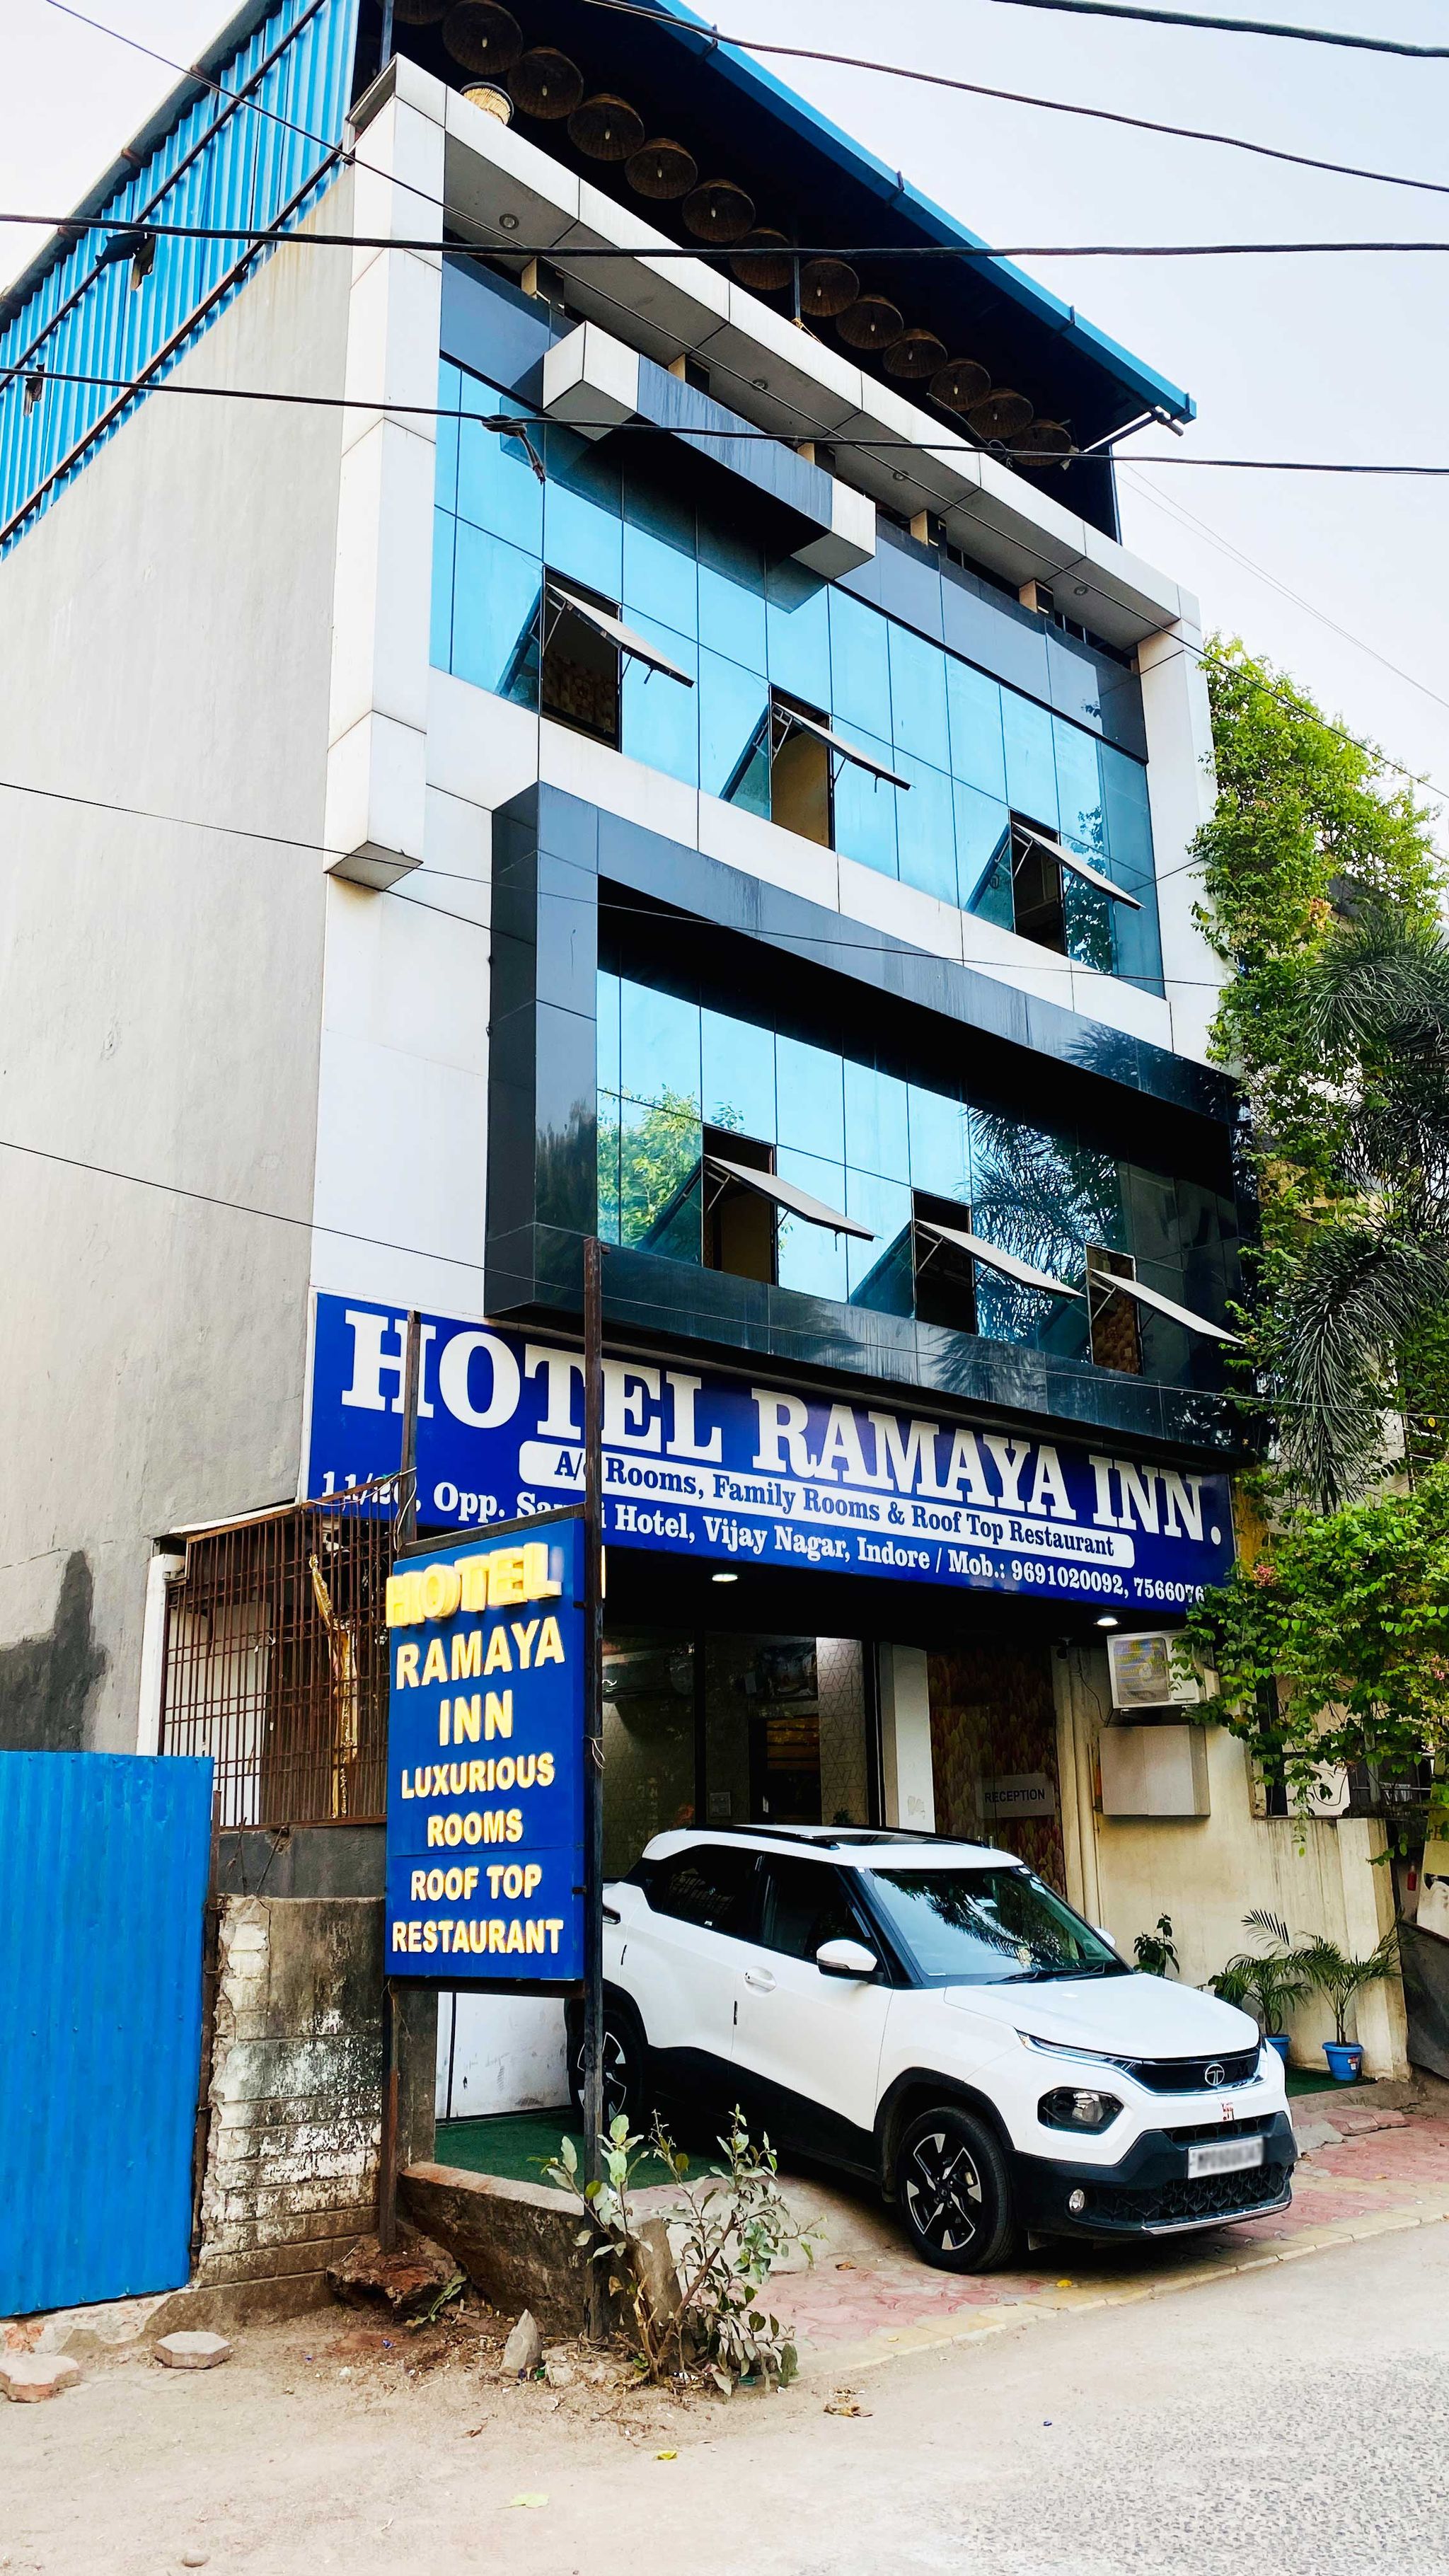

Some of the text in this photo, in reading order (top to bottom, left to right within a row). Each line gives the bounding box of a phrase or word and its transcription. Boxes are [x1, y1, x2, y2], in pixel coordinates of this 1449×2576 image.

[341, 1309, 1222, 1546] HOTEL RAMAYA INN.
[554, 1450, 1115, 1557] A/ Rooms, Family Rooms & Roof Top Restaurant
[433, 1482, 506, 1524] Opp.
[614, 1503, 696, 1544] Hotel,
[703, 1515, 768, 1556] Vijay
[774, 1525, 851, 1563] Nagar,
[857, 1536, 931, 1570] Indore
[935, 1547, 943, 1573] /
[947, 1549, 1006, 1580] Mob.:
[1011, 1559, 1129, 1599] 9691020092,
[1133, 1577, 1207, 1604] 7566076
[385, 1542, 562, 1628] HOTEL
[396, 1616, 566, 1690] RAMAYA
[439, 1689, 514, 1747] INN
[400, 1751, 555, 1799] LUXURIOUS
[983, 1788, 1046, 1803] RECEPTION
[427, 1808, 524, 1848] ROOMS
[410, 1864, 543, 1902] ROOF TOP
[391, 1918, 565, 1954] RESTAURANT
